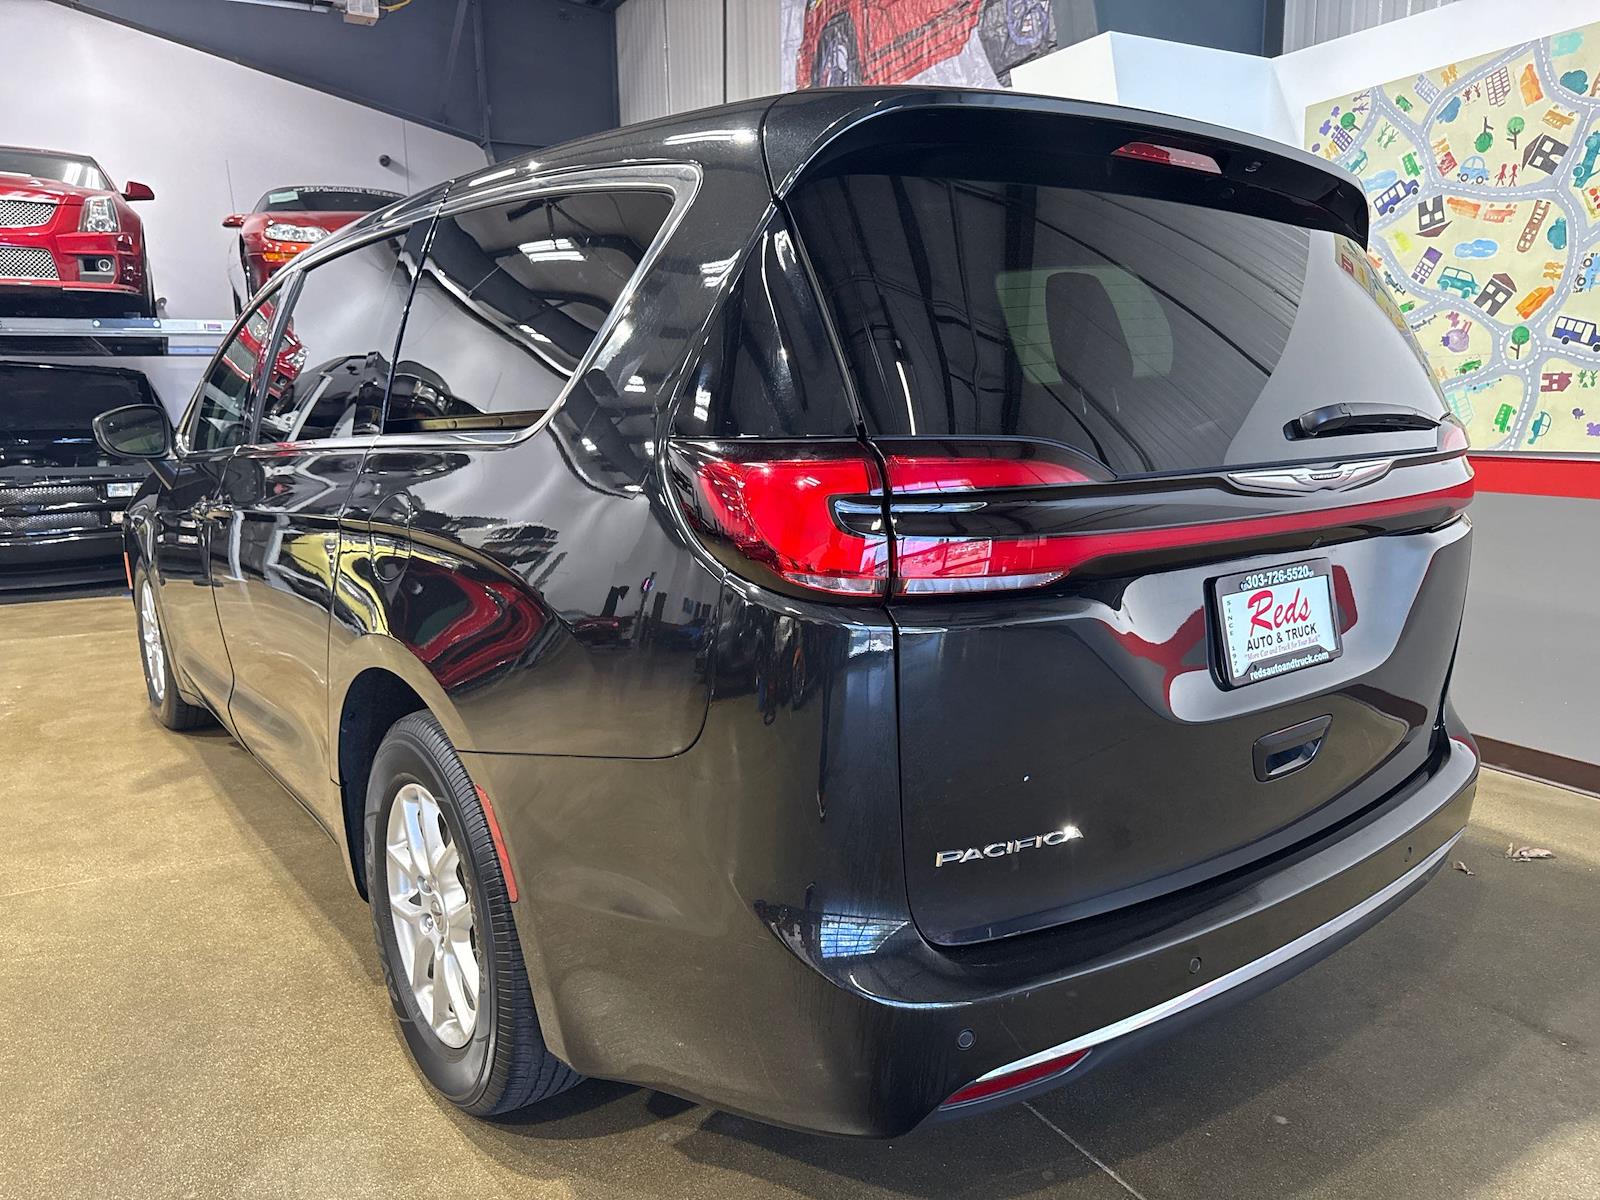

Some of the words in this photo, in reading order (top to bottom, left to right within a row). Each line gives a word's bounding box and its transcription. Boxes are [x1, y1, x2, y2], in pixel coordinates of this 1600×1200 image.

[1246, 565, 1309, 589] 303-726-5520
[1226, 600, 1234, 636] SINCE
[1247, 587, 1311, 636] Reds
[1247, 632, 1273, 652] AUTO
[1276, 632, 1283, 643] &
[1285, 623, 1317, 641] TRUCK
[1249, 651, 1329, 680] redsautoandtruck.com
[935, 825, 1084, 867] PACIFICA
